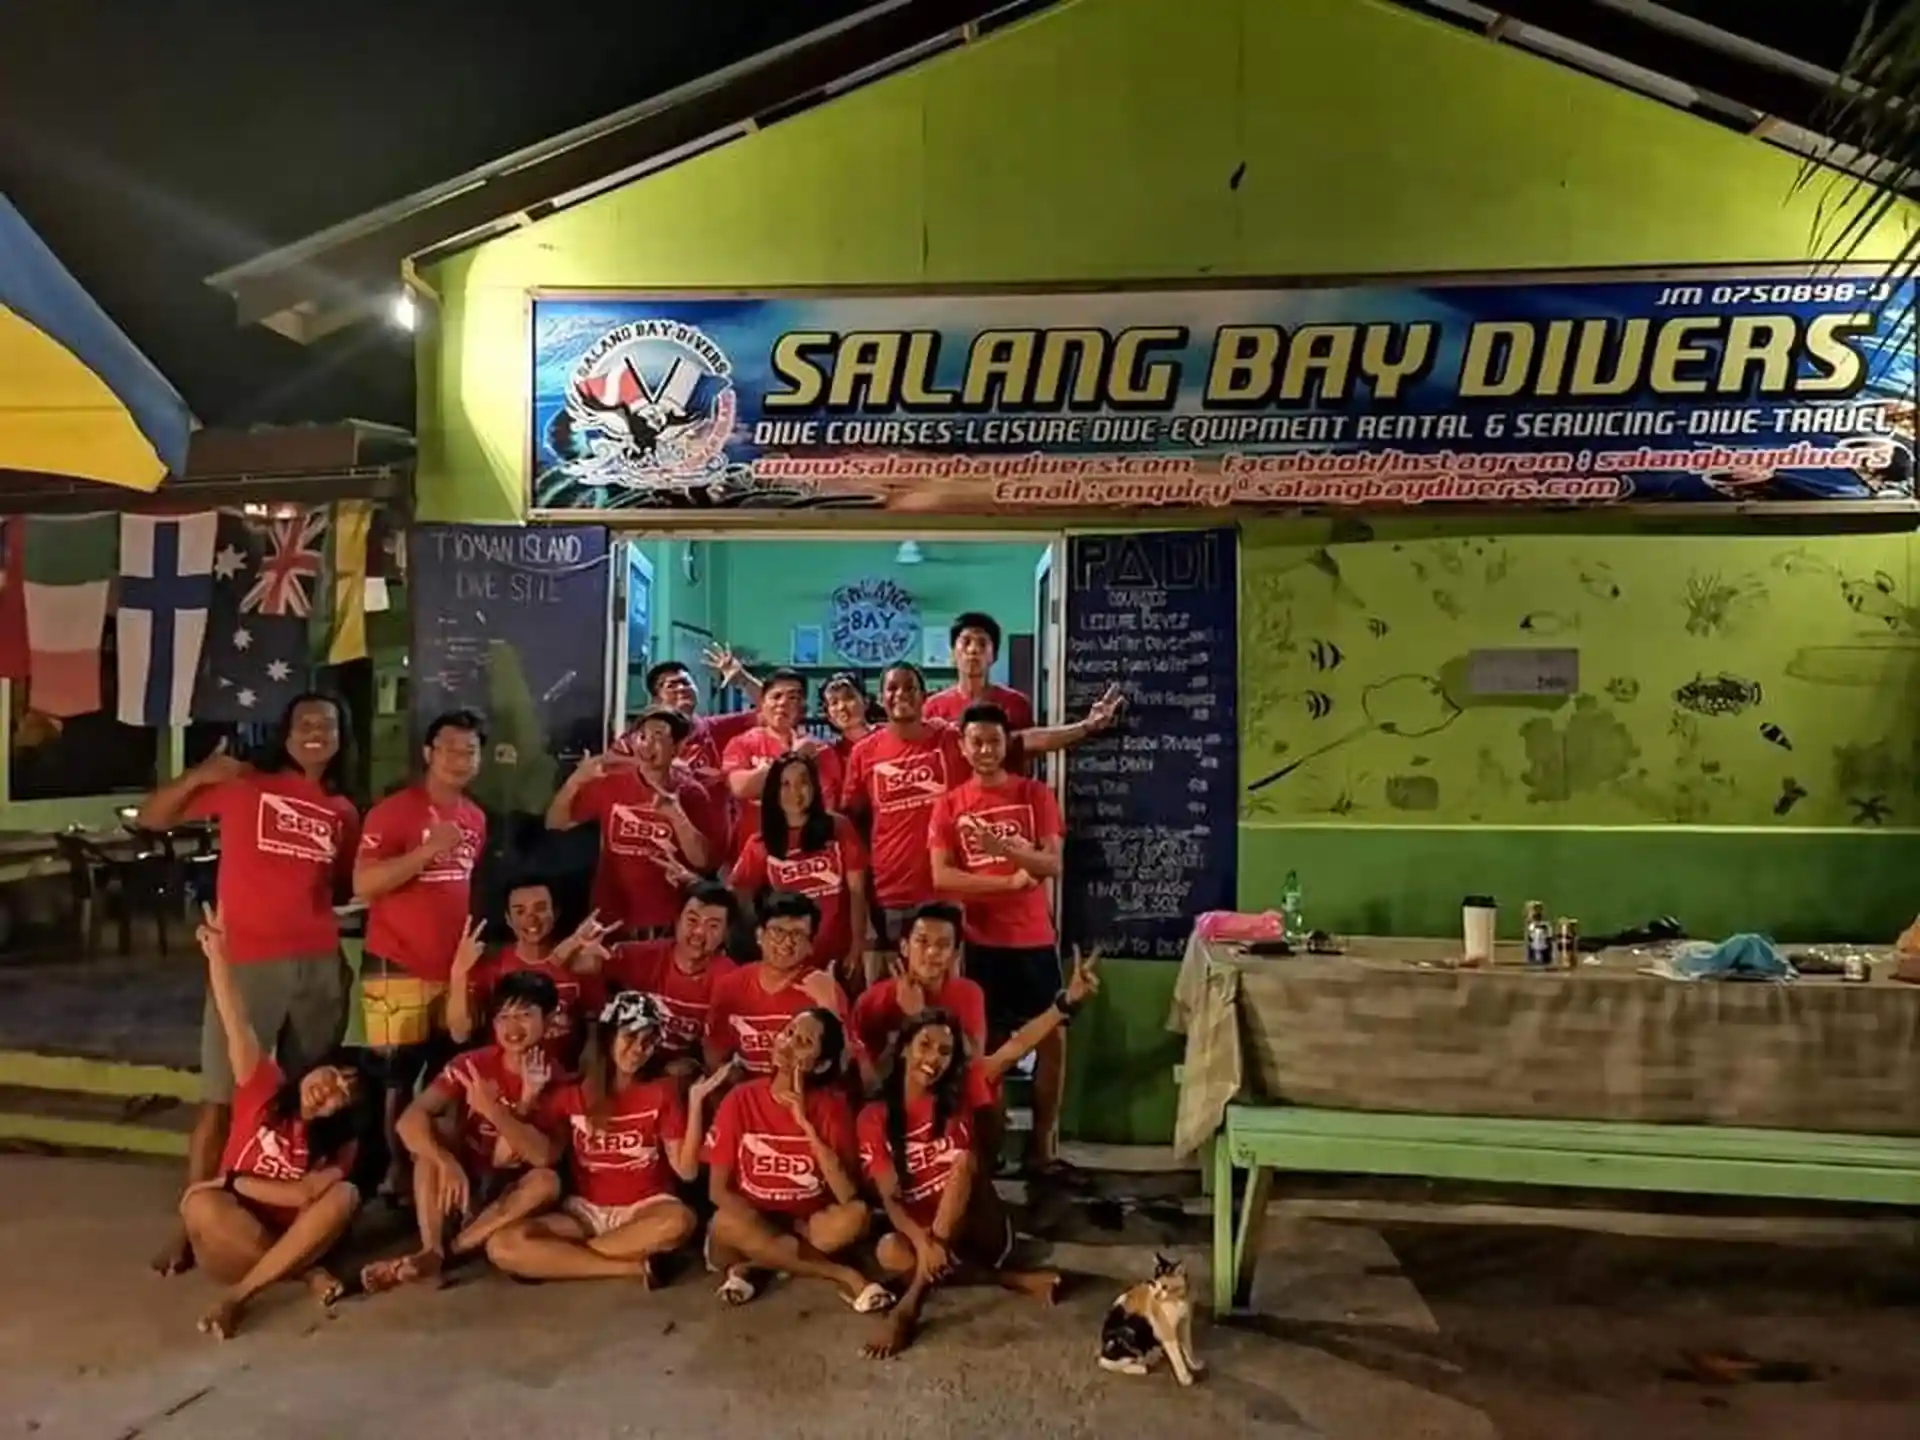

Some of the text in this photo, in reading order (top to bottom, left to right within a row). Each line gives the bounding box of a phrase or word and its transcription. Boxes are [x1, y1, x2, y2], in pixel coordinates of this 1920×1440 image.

[1656, 287, 1703, 306] JM
[635, 321, 673, 338] BAY
[675, 327, 730, 374] DIVERS
[763, 311, 1872, 412] SALANG BAY DIVERS
[753, 421, 819, 445] DIVE
[1356, 414, 1473, 439] RENTAL
[1484, 413, 1507, 438] &
[1595, 442, 1893, 471] salangbaydivers
[519, 532, 583, 564] ISLAND
[1073, 534, 1221, 592] PADI
[850, 611, 896, 632] BAY
[621, 820, 673, 841] SBD
[780, 856, 830, 884] SBD
[753, 1153, 815, 1176] SBD
